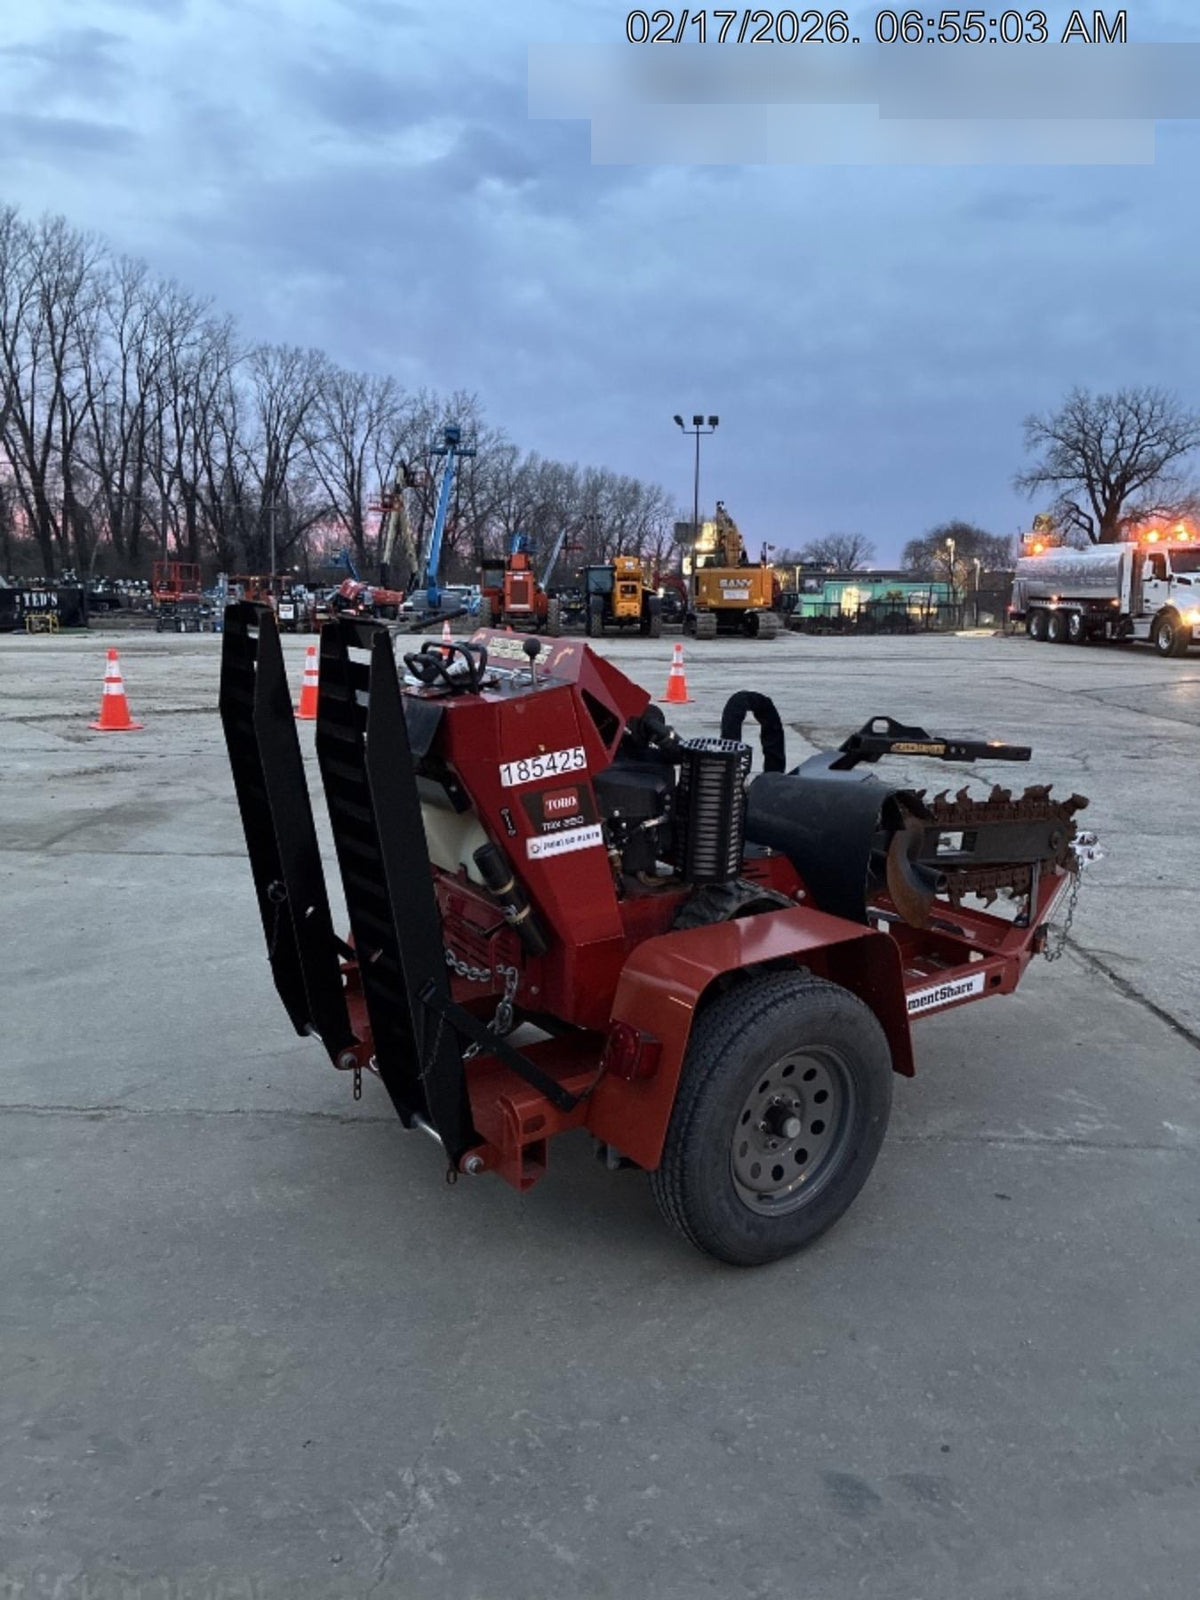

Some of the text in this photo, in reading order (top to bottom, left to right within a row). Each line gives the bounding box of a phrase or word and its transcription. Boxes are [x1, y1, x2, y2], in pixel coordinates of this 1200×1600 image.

[502, 748, 584, 785] 185425
[545, 796, 577, 811] TORO
[908, 980, 973, 1010] mentShare
